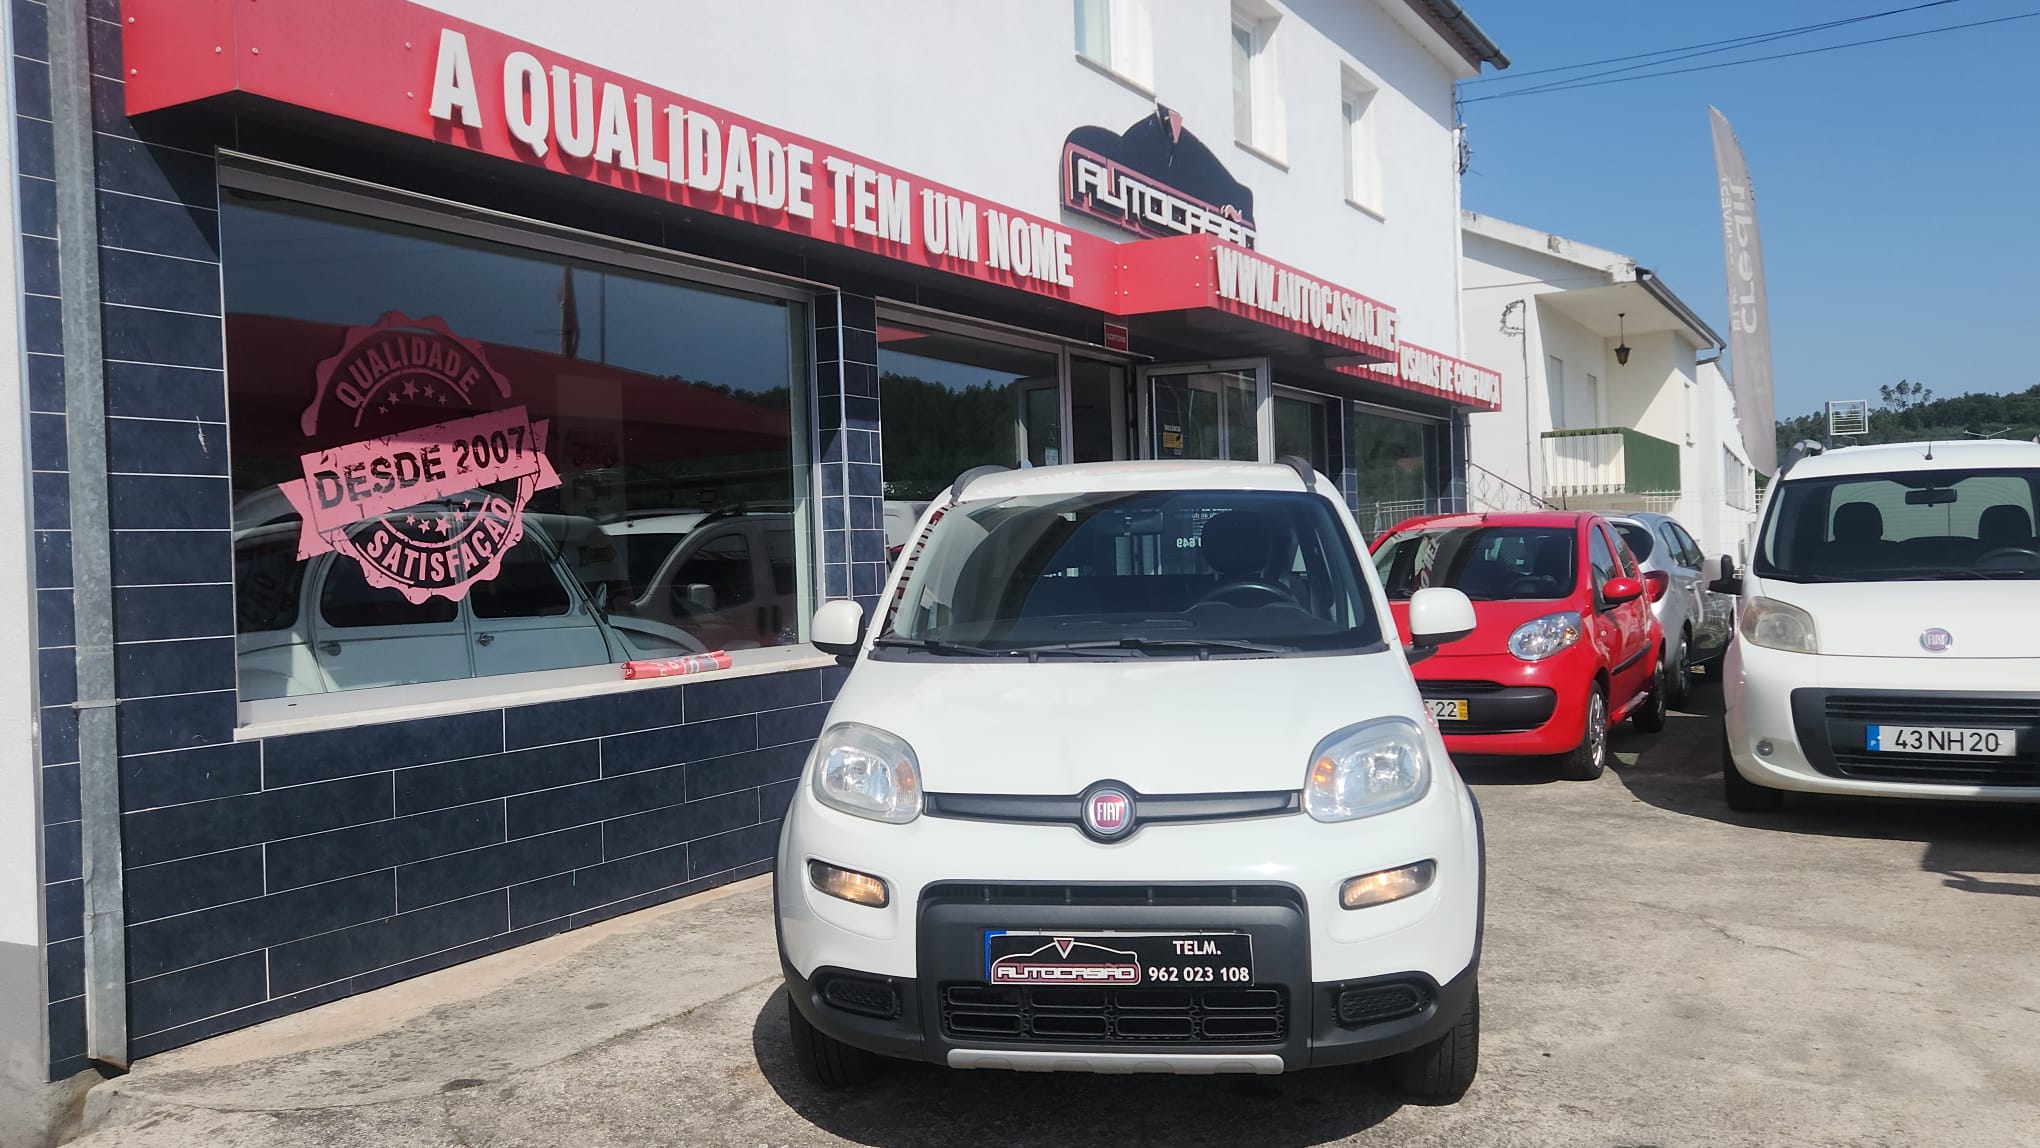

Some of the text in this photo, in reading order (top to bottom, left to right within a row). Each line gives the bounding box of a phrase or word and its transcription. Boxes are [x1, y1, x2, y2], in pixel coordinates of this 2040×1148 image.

[429, 28, 1074, 288] A QUALIDADE TEM UM NOME
[335, 336, 480, 409] QUALIDADE
[313, 425, 526, 510] DESDE 2007
[1096, 801, 1125, 822] FIAT
[1173, 940, 1222, 956] TELM.
[1148, 967, 1250, 982] 962 023 108
